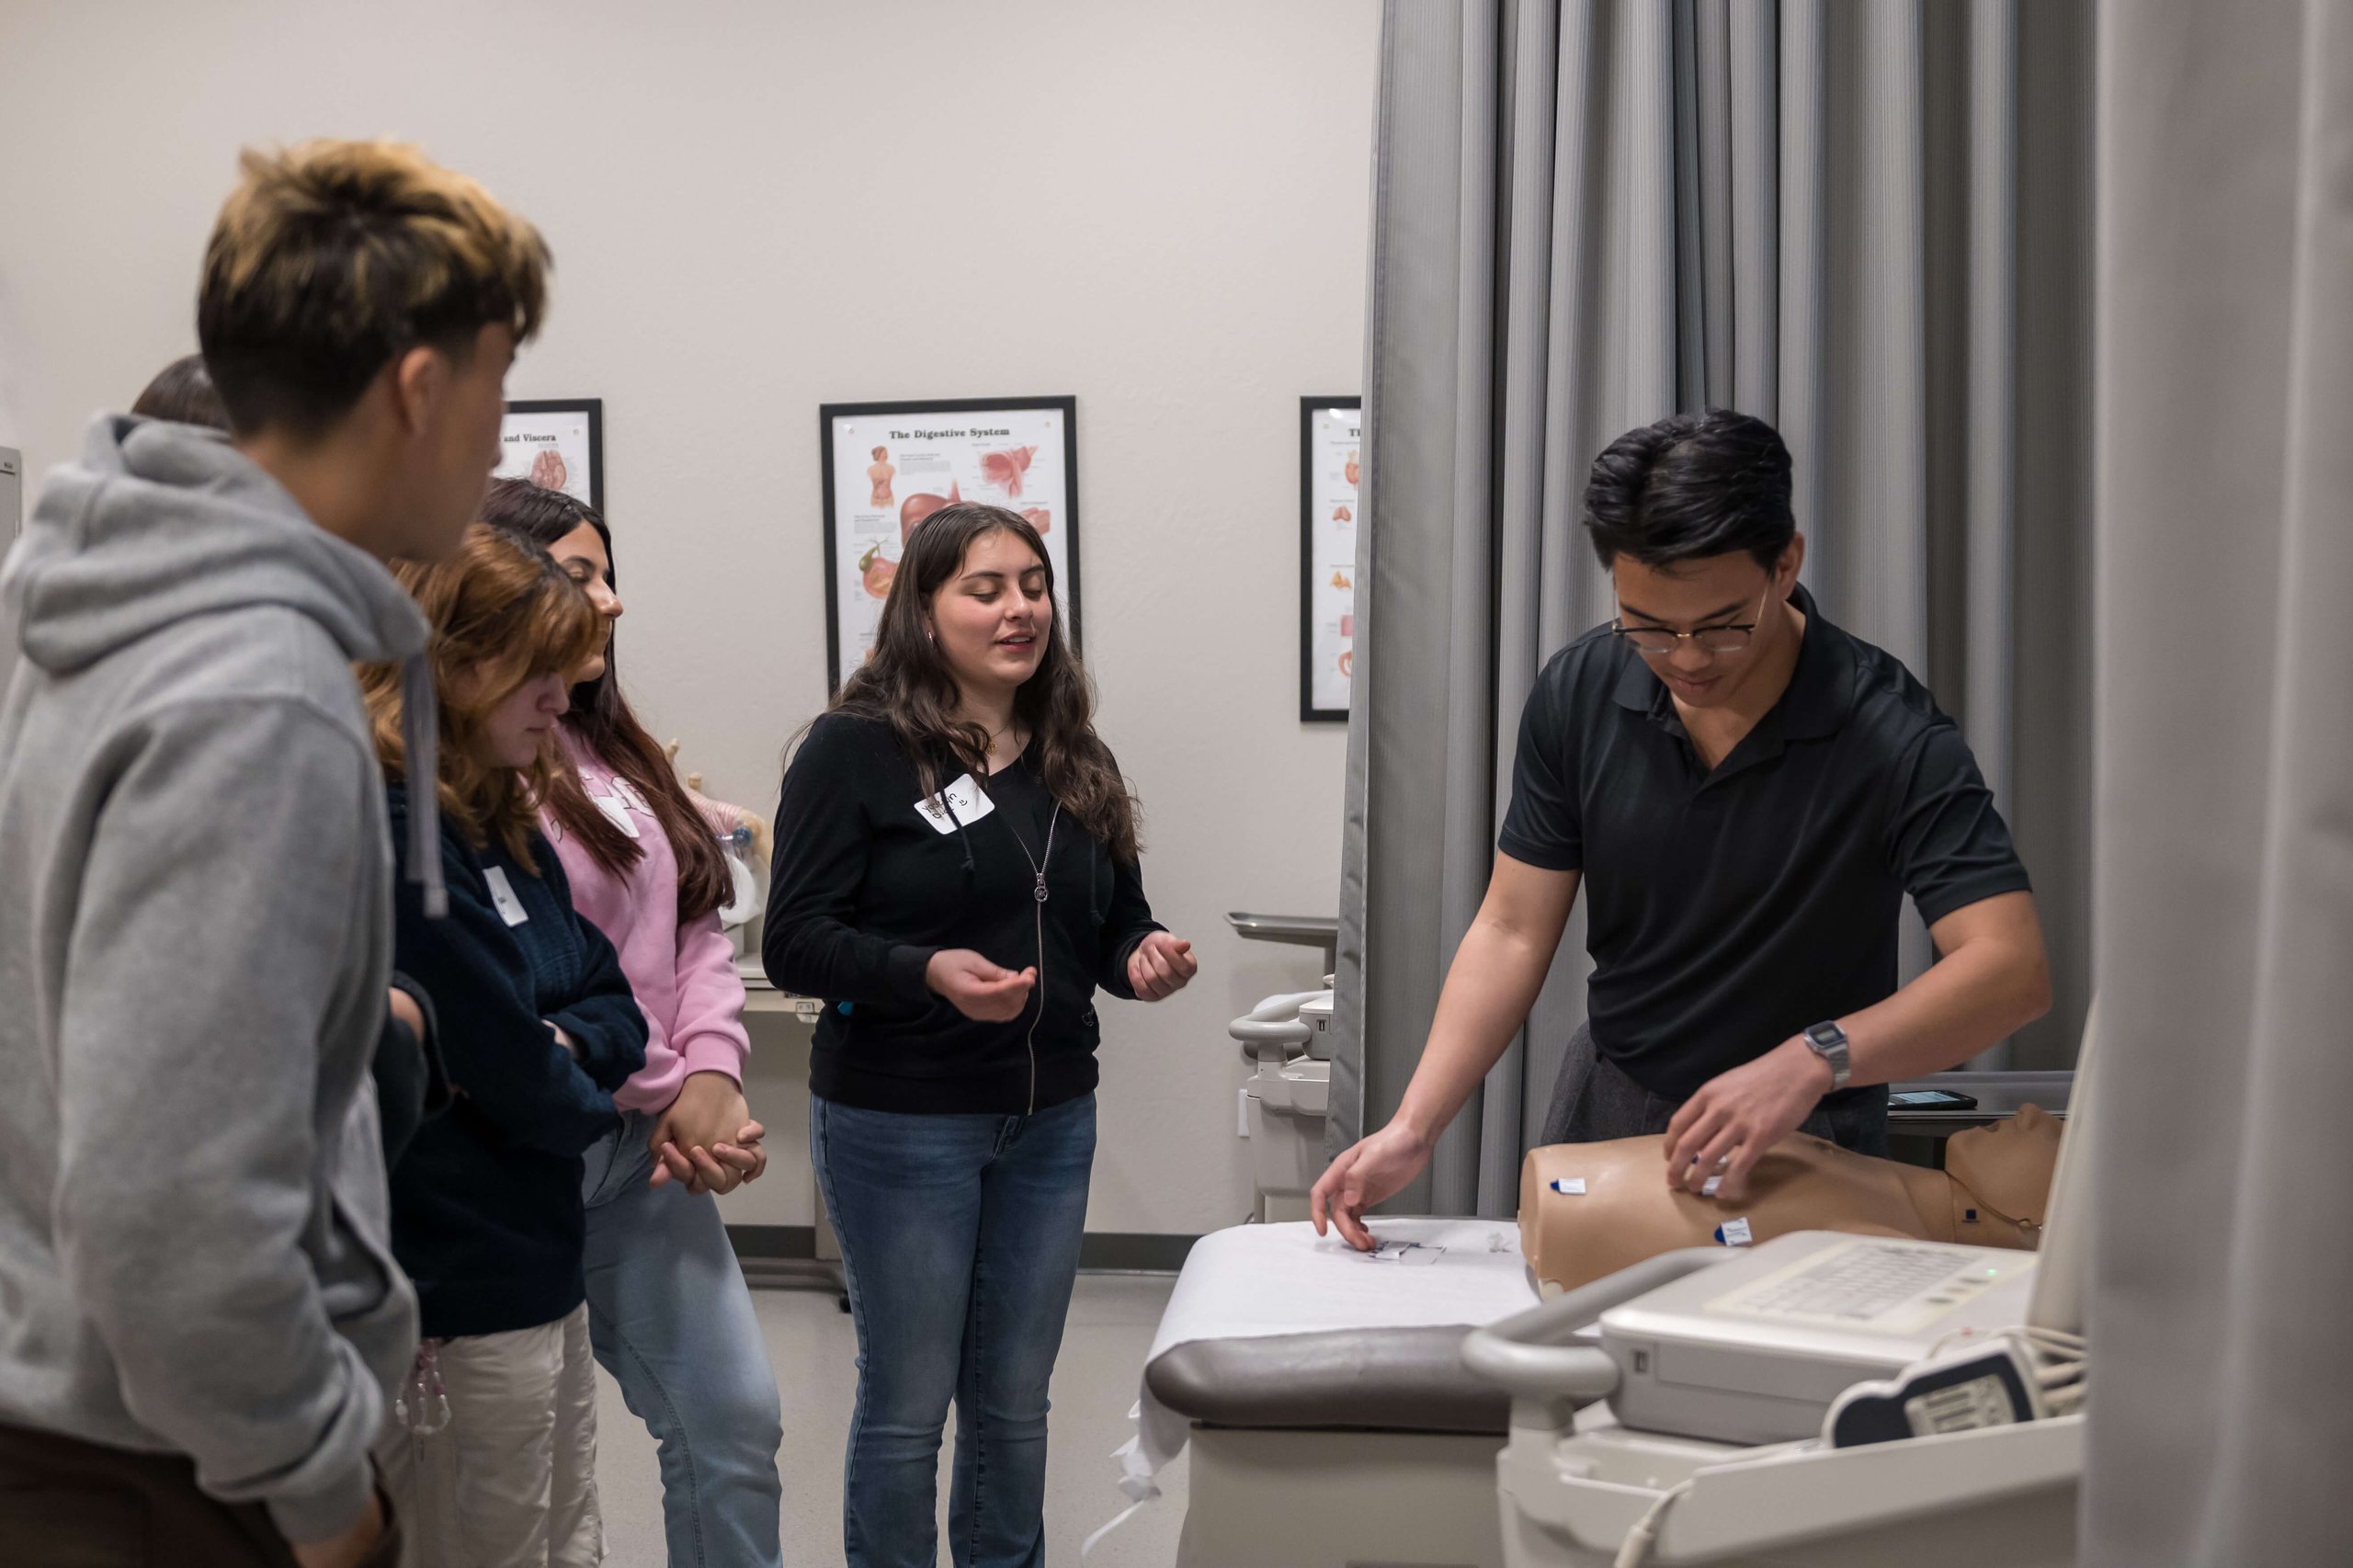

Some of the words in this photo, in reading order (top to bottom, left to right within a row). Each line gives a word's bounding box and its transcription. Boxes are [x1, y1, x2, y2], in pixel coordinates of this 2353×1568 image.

[889, 430, 910, 439] The
[915, 429, 966, 440] Digestive
[970, 427, 1010, 438] System
